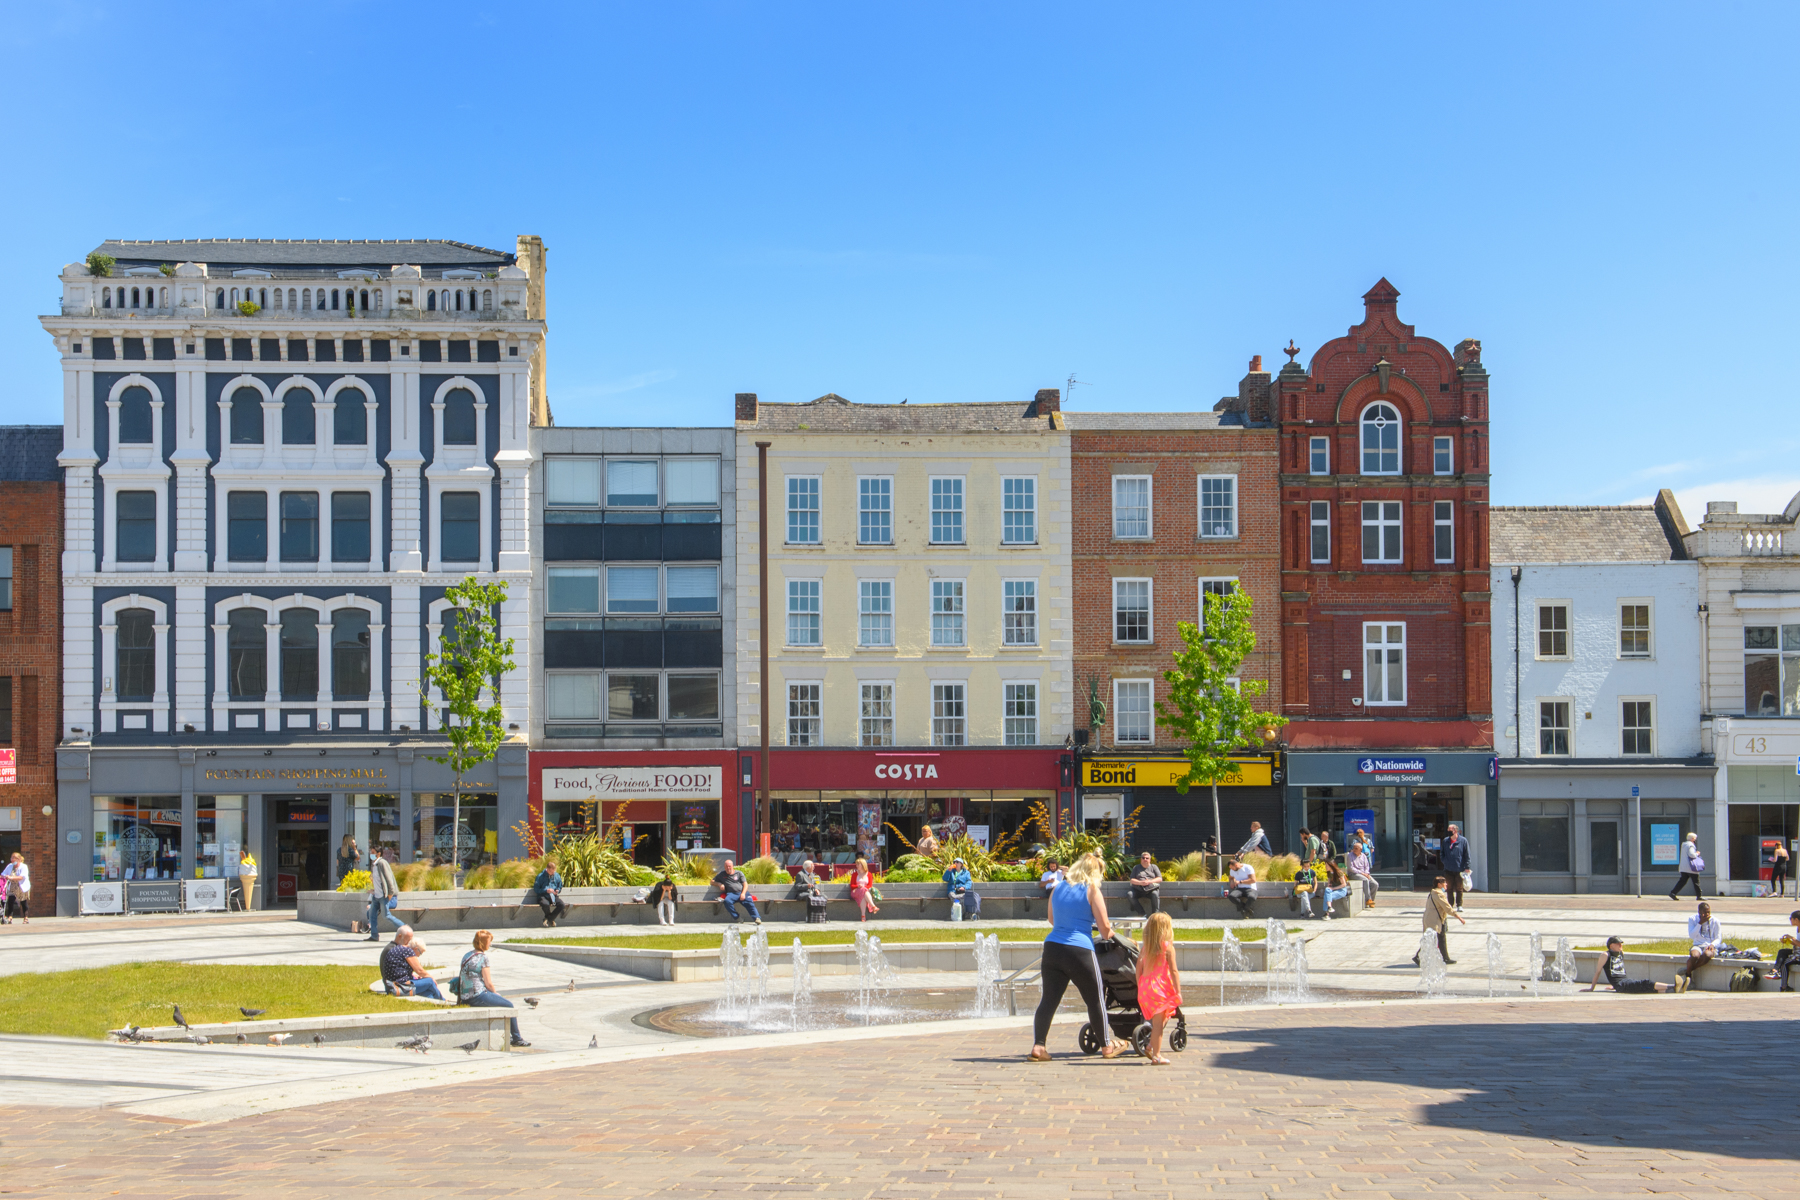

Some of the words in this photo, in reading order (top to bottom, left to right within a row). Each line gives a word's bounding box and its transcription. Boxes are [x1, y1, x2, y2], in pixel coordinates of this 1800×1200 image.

[1745, 737, 1767, 753] 43
[2, 767, 16, 775] OFFER
[875, 764, 938, 780] COSTA
[1375, 760, 1424, 770] Nationwide
[206, 769, 276, 779] FOUNTAIN
[279, 769, 347, 779] SHOPPING
[350, 768, 388, 779] MALL
[1091, 768, 1136, 783] Bond
[554, 777, 592, 791] Food,
[595, 773, 653, 792] Glorious
[653, 774, 712, 787] FOOD!
